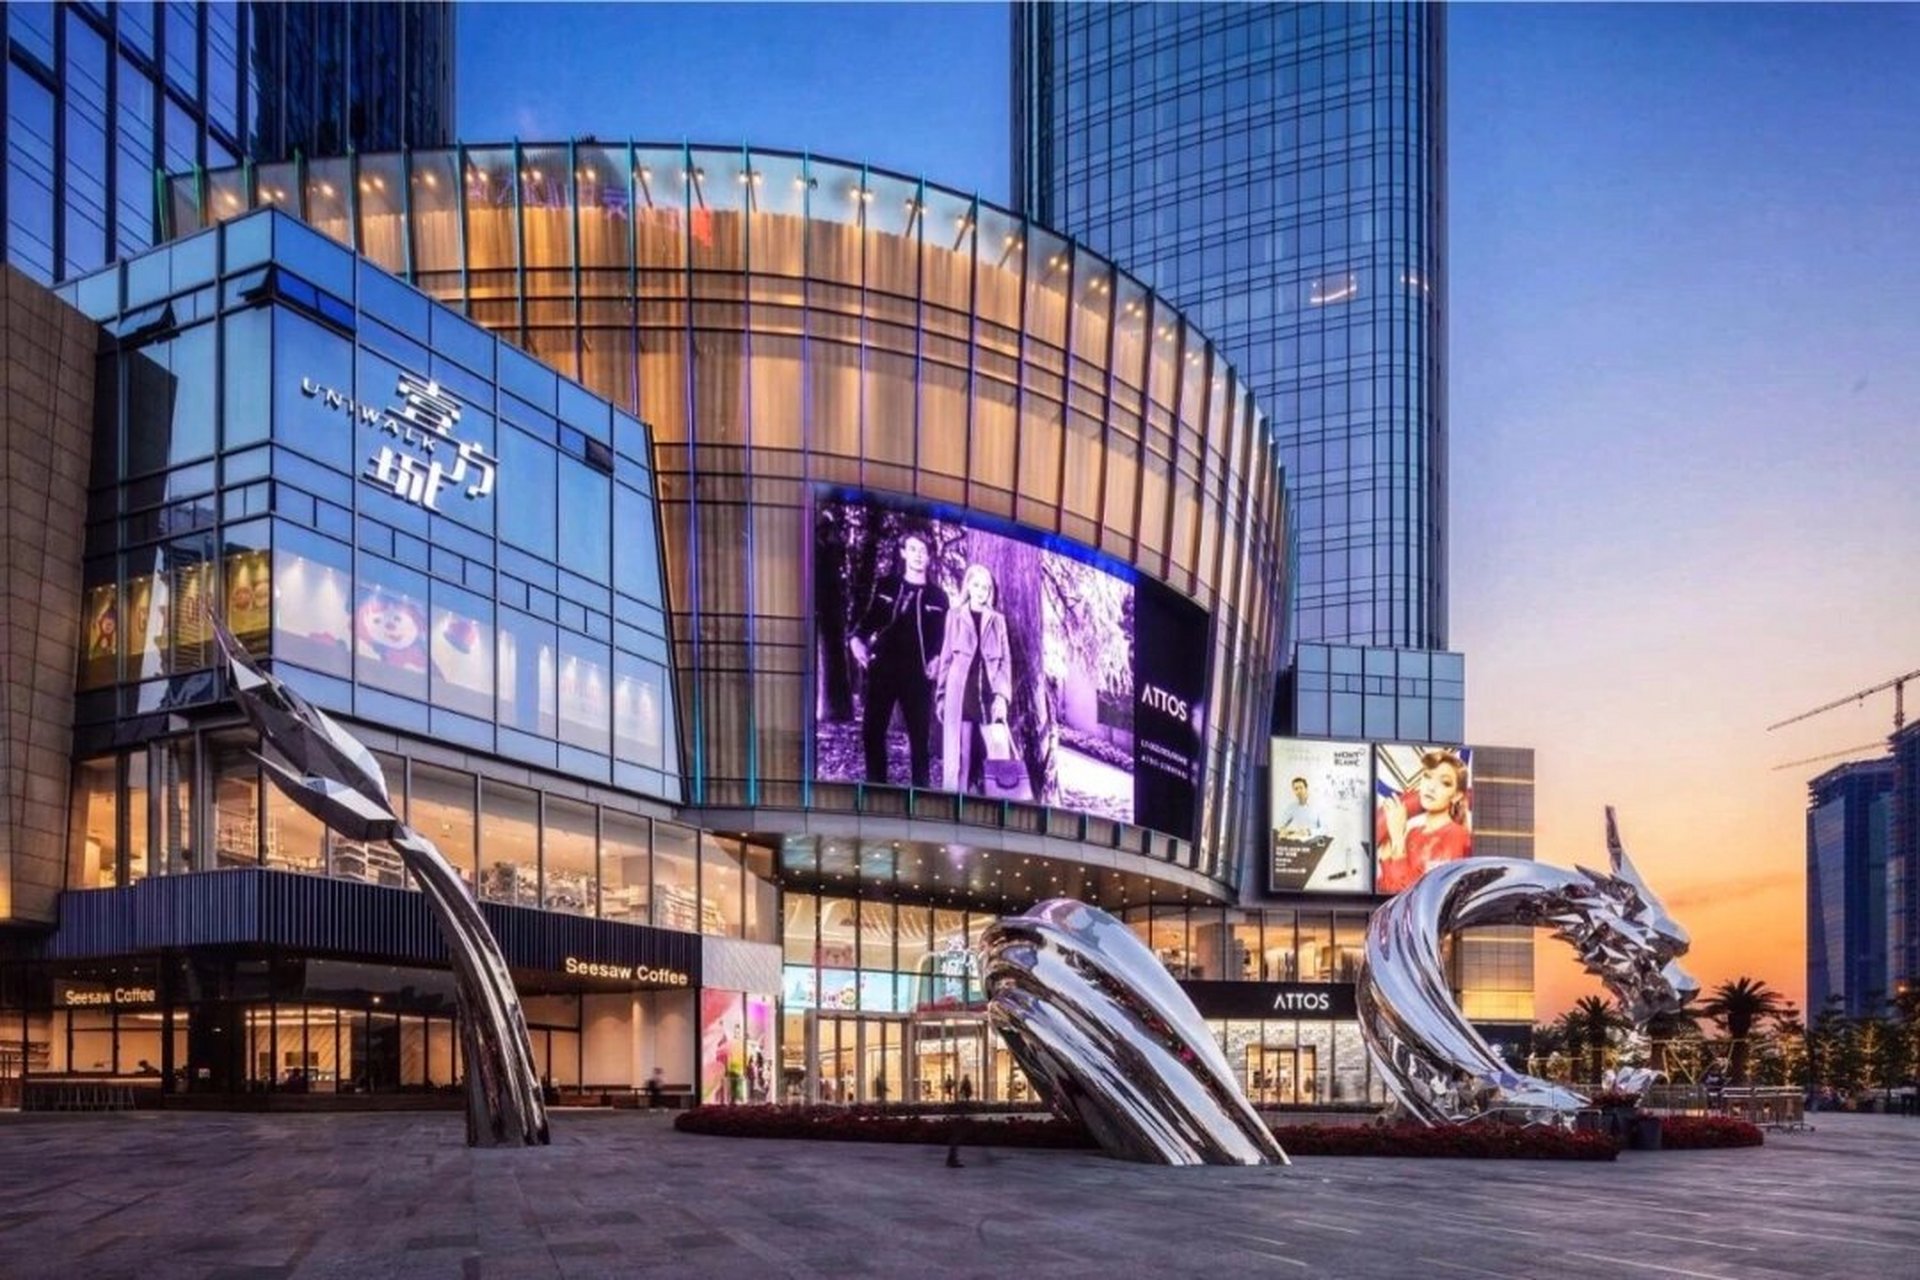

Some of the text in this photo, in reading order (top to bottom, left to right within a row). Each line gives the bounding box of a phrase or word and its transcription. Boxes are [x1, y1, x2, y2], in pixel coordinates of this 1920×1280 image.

[302, 376, 435, 454] UNIWALK
[1141, 682, 1187, 722] ATTOS
[565, 957, 688, 985] Seesaw Coffee
[65, 987, 156, 1005] Seesaw Coffee
[1273, 993, 1330, 1010] ATTOS
